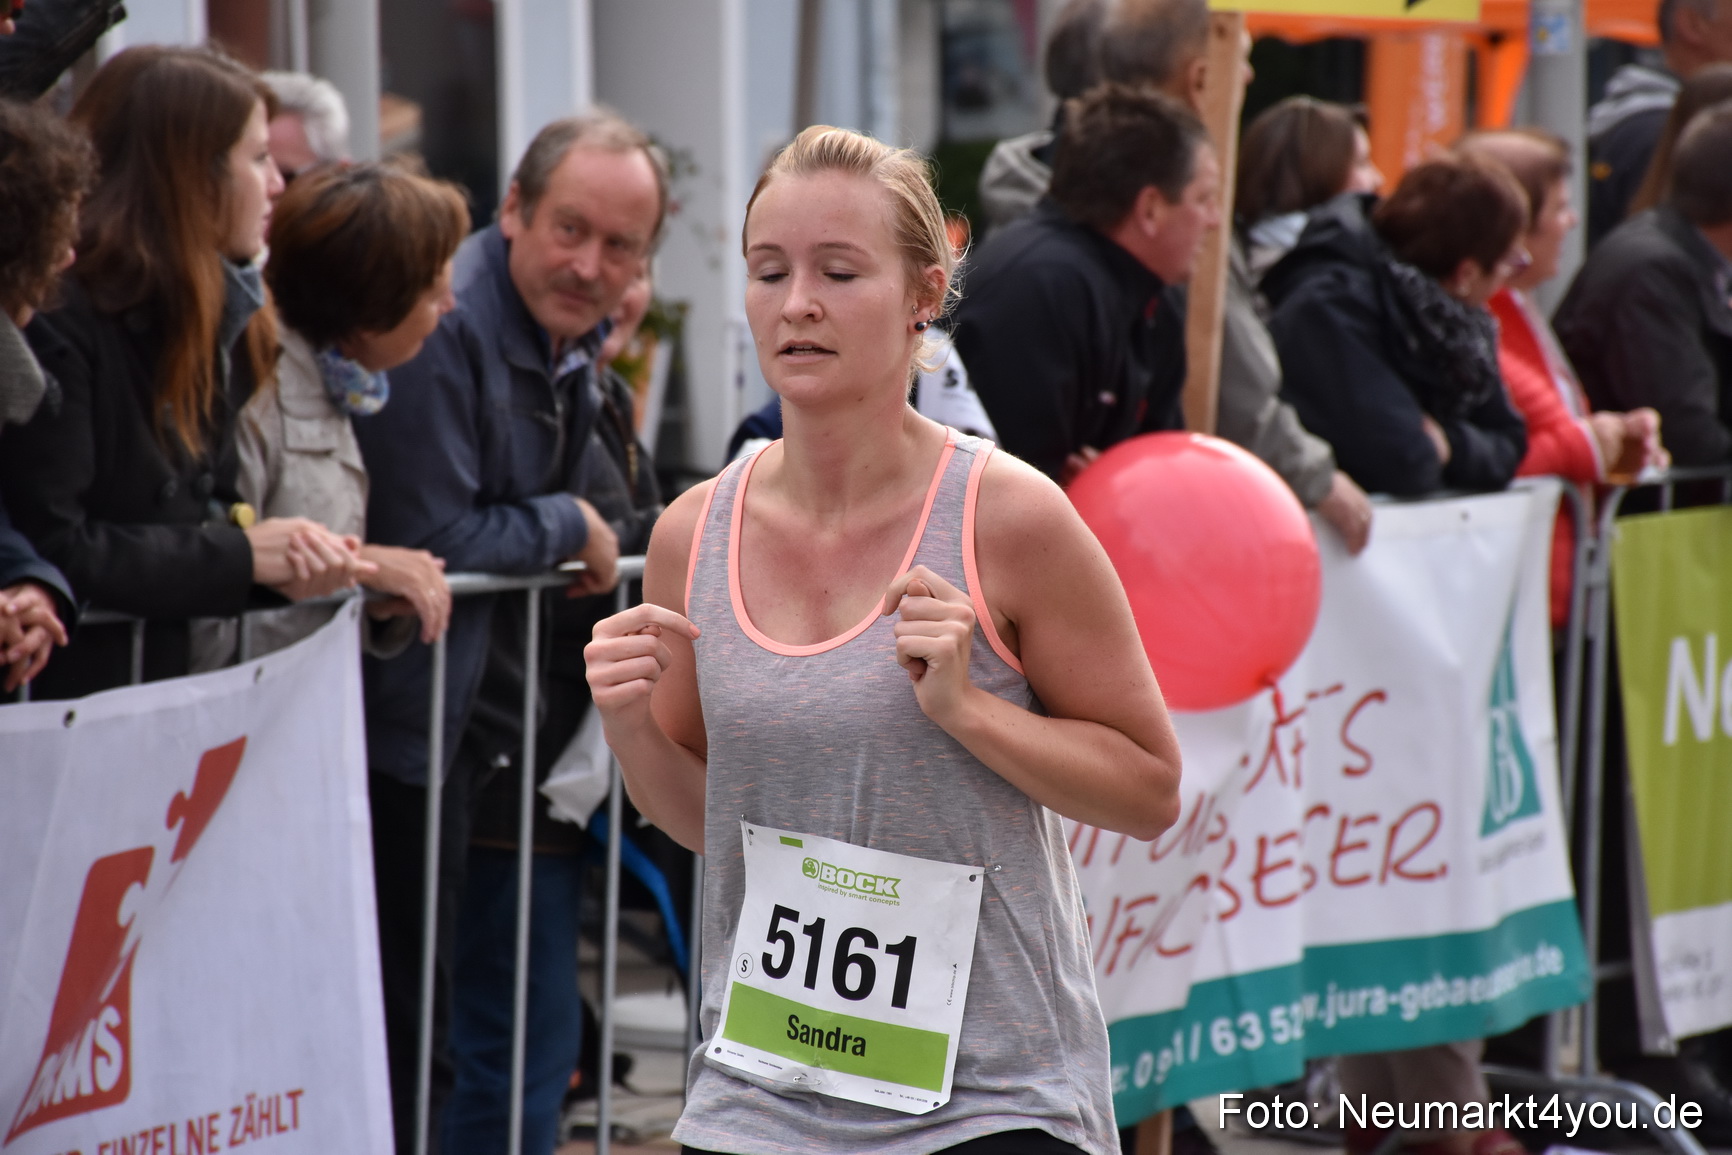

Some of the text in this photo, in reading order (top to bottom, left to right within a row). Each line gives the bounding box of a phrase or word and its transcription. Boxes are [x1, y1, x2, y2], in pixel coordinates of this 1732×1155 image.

[818, 884, 900, 906] inspired by smart concepts
[819, 862, 901, 898] BOCK
[761, 903, 918, 1010] 5161
[786, 1014, 867, 1058] Sandra
[1210, 1010, 1265, 1056] 63
[228, 1088, 304, 1148] ZÄHLT
